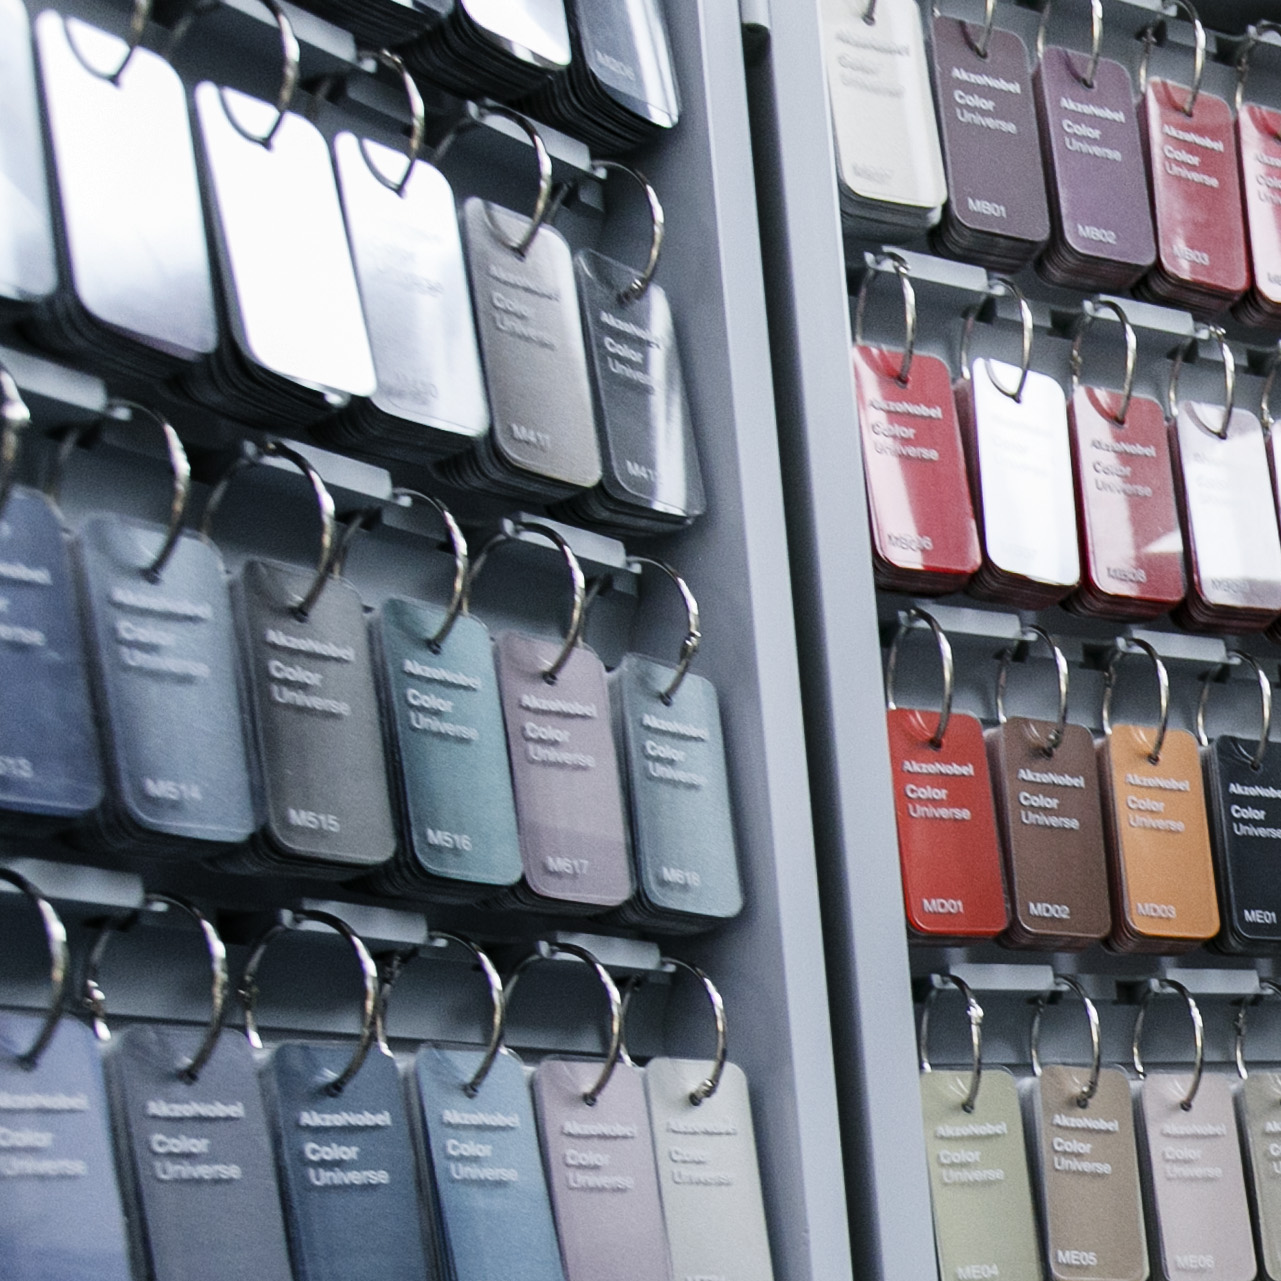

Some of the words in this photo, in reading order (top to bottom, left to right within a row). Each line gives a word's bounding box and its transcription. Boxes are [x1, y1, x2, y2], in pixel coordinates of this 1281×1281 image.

[952, 68, 1021, 93] AkzoNobel
[954, 90, 995, 110] Color
[1061, 98, 1125, 122] AkzoNobel
[956, 108, 1016, 133] Universe
[1063, 119, 1101, 139] Color
[1065, 137, 1122, 161] Universe
[967, 197, 1006, 217] MB01
[1078, 224, 1116, 244] MB02
[404, 659, 480, 686] AkzoNobel
[407, 688, 453, 711] Color
[409, 711, 476, 738] Universe
[904, 761, 974, 775] AkzoNobel
[1019, 769, 1085, 787] AkzoNobel
[1127, 774, 1190, 791] AkzoNobel
[906, 784, 948, 799] Color
[1020, 792, 1059, 808] Color
[909, 804, 971, 819] Universe
[1128, 795, 1165, 811] Color
[1021, 811, 1079, 829] Universe
[1231, 805, 1265, 819] Color
[1130, 814, 1185, 831] Universe
[427, 828, 474, 853] M516
[923, 898, 964, 913] MD01
[1029, 902, 1070, 919] MD02
[1137, 903, 1176, 918] MD03
[1244, 909, 1277, 923] ME01
[300, 1111, 391, 1126] AkzoNobel
[443, 1110, 520, 1126] AkzoNobel
[1054, 1114, 1119, 1131] AkzoNobel
[304, 1142, 359, 1160] Color
[446, 1139, 492, 1156] Color
[1053, 1137, 1092, 1153] Color
[449, 1163, 518, 1180] Universe
[1054, 1157, 1111, 1173] Universe
[308, 1168, 389, 1185] Universe
[1058, 1250, 1097, 1265] ME05
